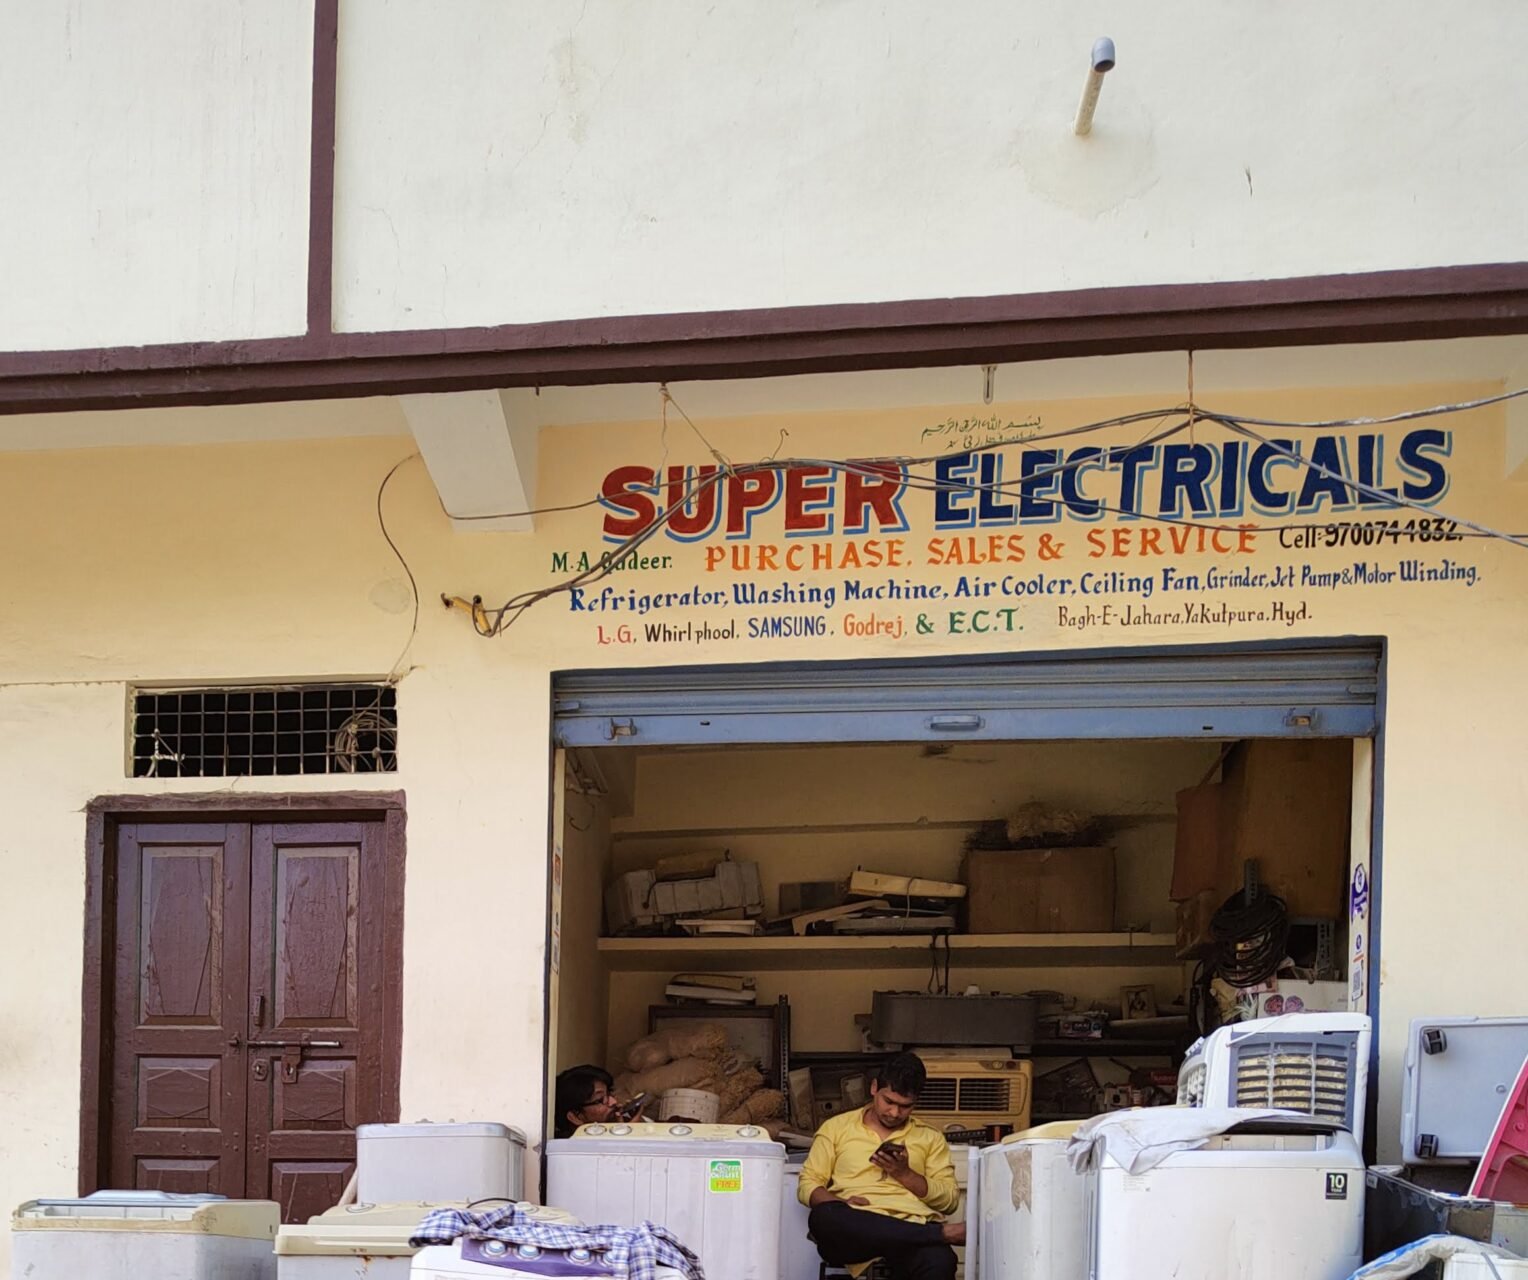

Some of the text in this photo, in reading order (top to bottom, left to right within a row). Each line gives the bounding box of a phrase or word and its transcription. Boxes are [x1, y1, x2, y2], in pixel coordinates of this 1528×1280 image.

[598, 429, 1453, 543] SUPER ELECTRICALS
[927, 534, 1026, 565] SALES
[1037, 533, 1065, 562] &
[1086, 523, 1260, 558] SERVICE
[569, 585, 729, 615] Refrigerator,
[732, 581, 836, 609] Washing
[844, 579, 949, 601] Machine,
[954, 576, 997, 599] Air
[1080, 571, 1154, 598] Ceiling
[915, 612, 935, 635] &
[1329, 1174, 1345, 1189] 10
